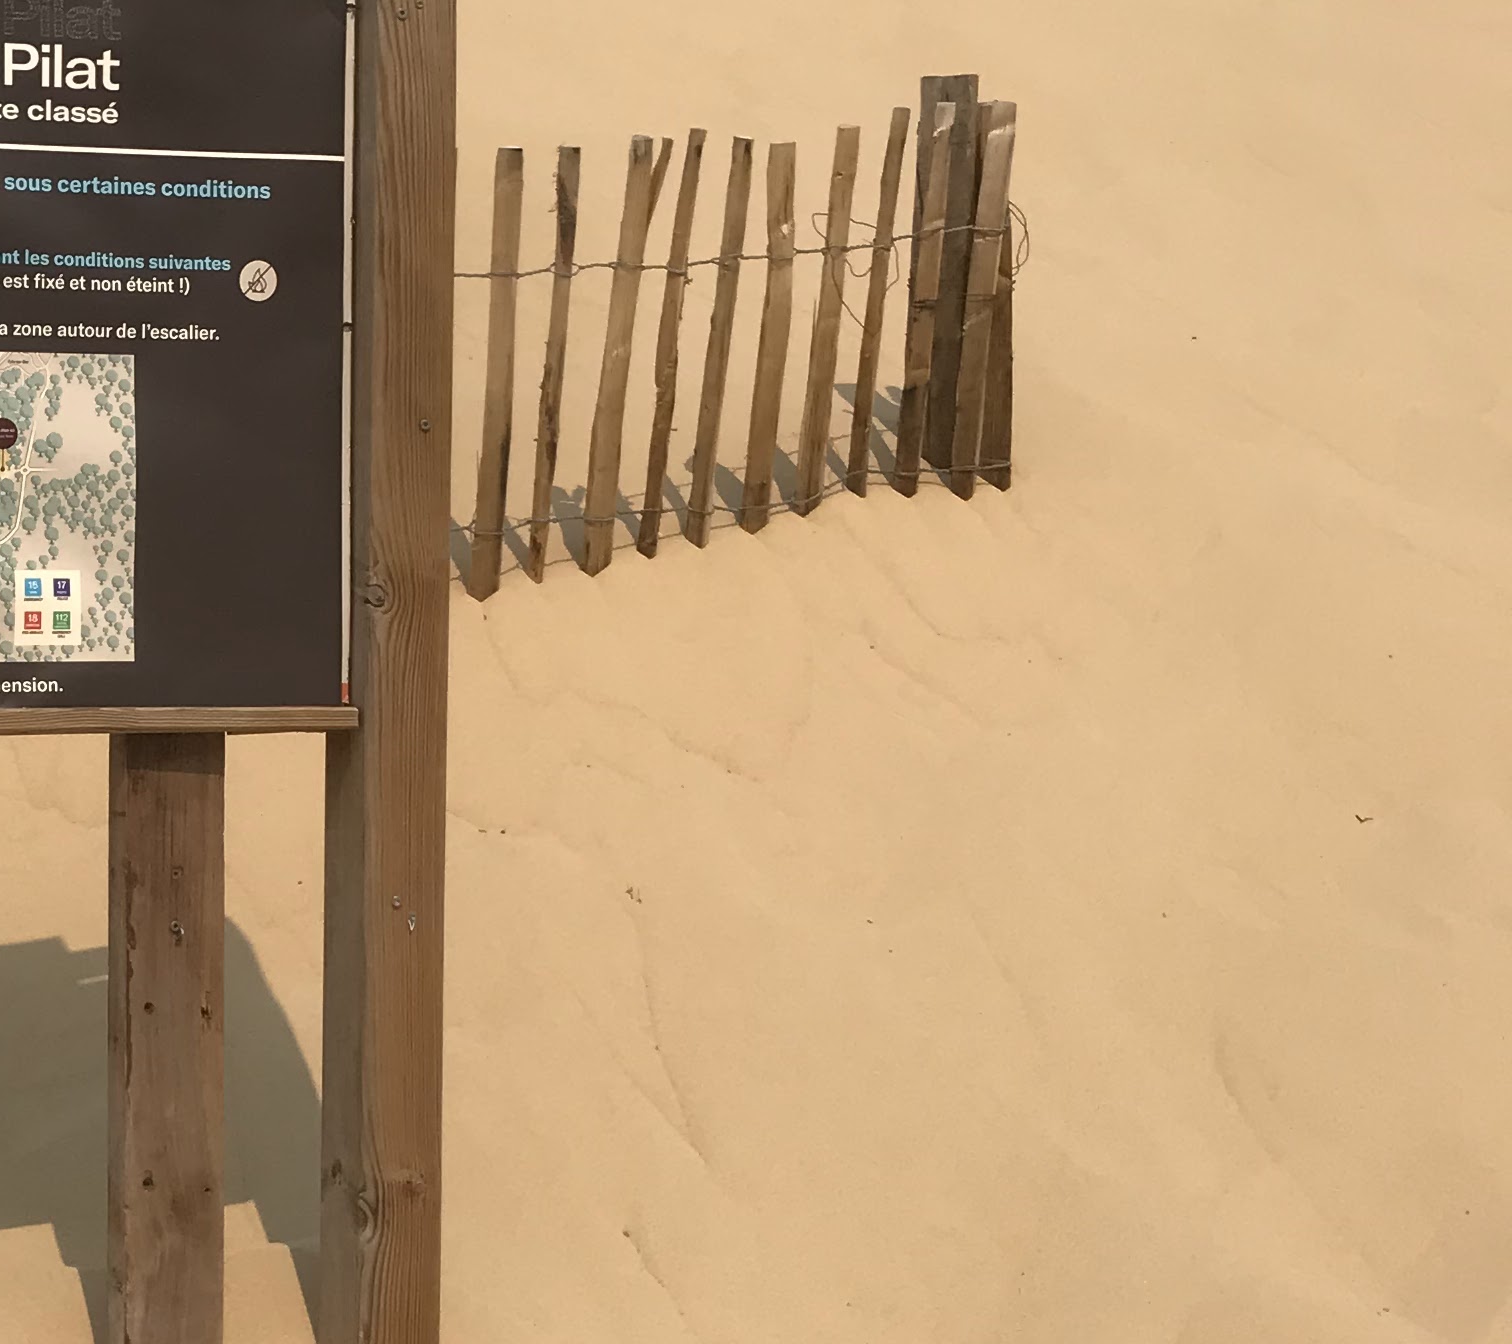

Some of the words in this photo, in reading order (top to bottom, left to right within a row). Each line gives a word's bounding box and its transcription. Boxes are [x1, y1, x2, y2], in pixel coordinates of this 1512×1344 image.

[4, 43, 120, 90] Pilat
[27, 99, 118, 124] classé
[5, 177, 52, 191] sous
[58, 176, 155, 195] certaines
[162, 180, 270, 199] conditions
[25, 249, 49, 265] les
[54, 252, 144, 268] conditions
[149, 255, 230, 270] suivantes
[3, 274, 29, 288] est
[34, 273, 64, 289] fixé
[70, 276, 86, 290] et
[91, 279, 121, 291] non
[127, 276, 174, 293] éteint
[13, 324, 52, 336] zone
[58, 323, 113, 338] autour
[116, 323, 136, 338] de
[142, 324, 219, 340] l’escalier.
[28, 580, 39, 589] 15
[57, 580, 67, 589] 17
[28, 613, 39, 623] 18
[55, 613, 69, 622] 112
